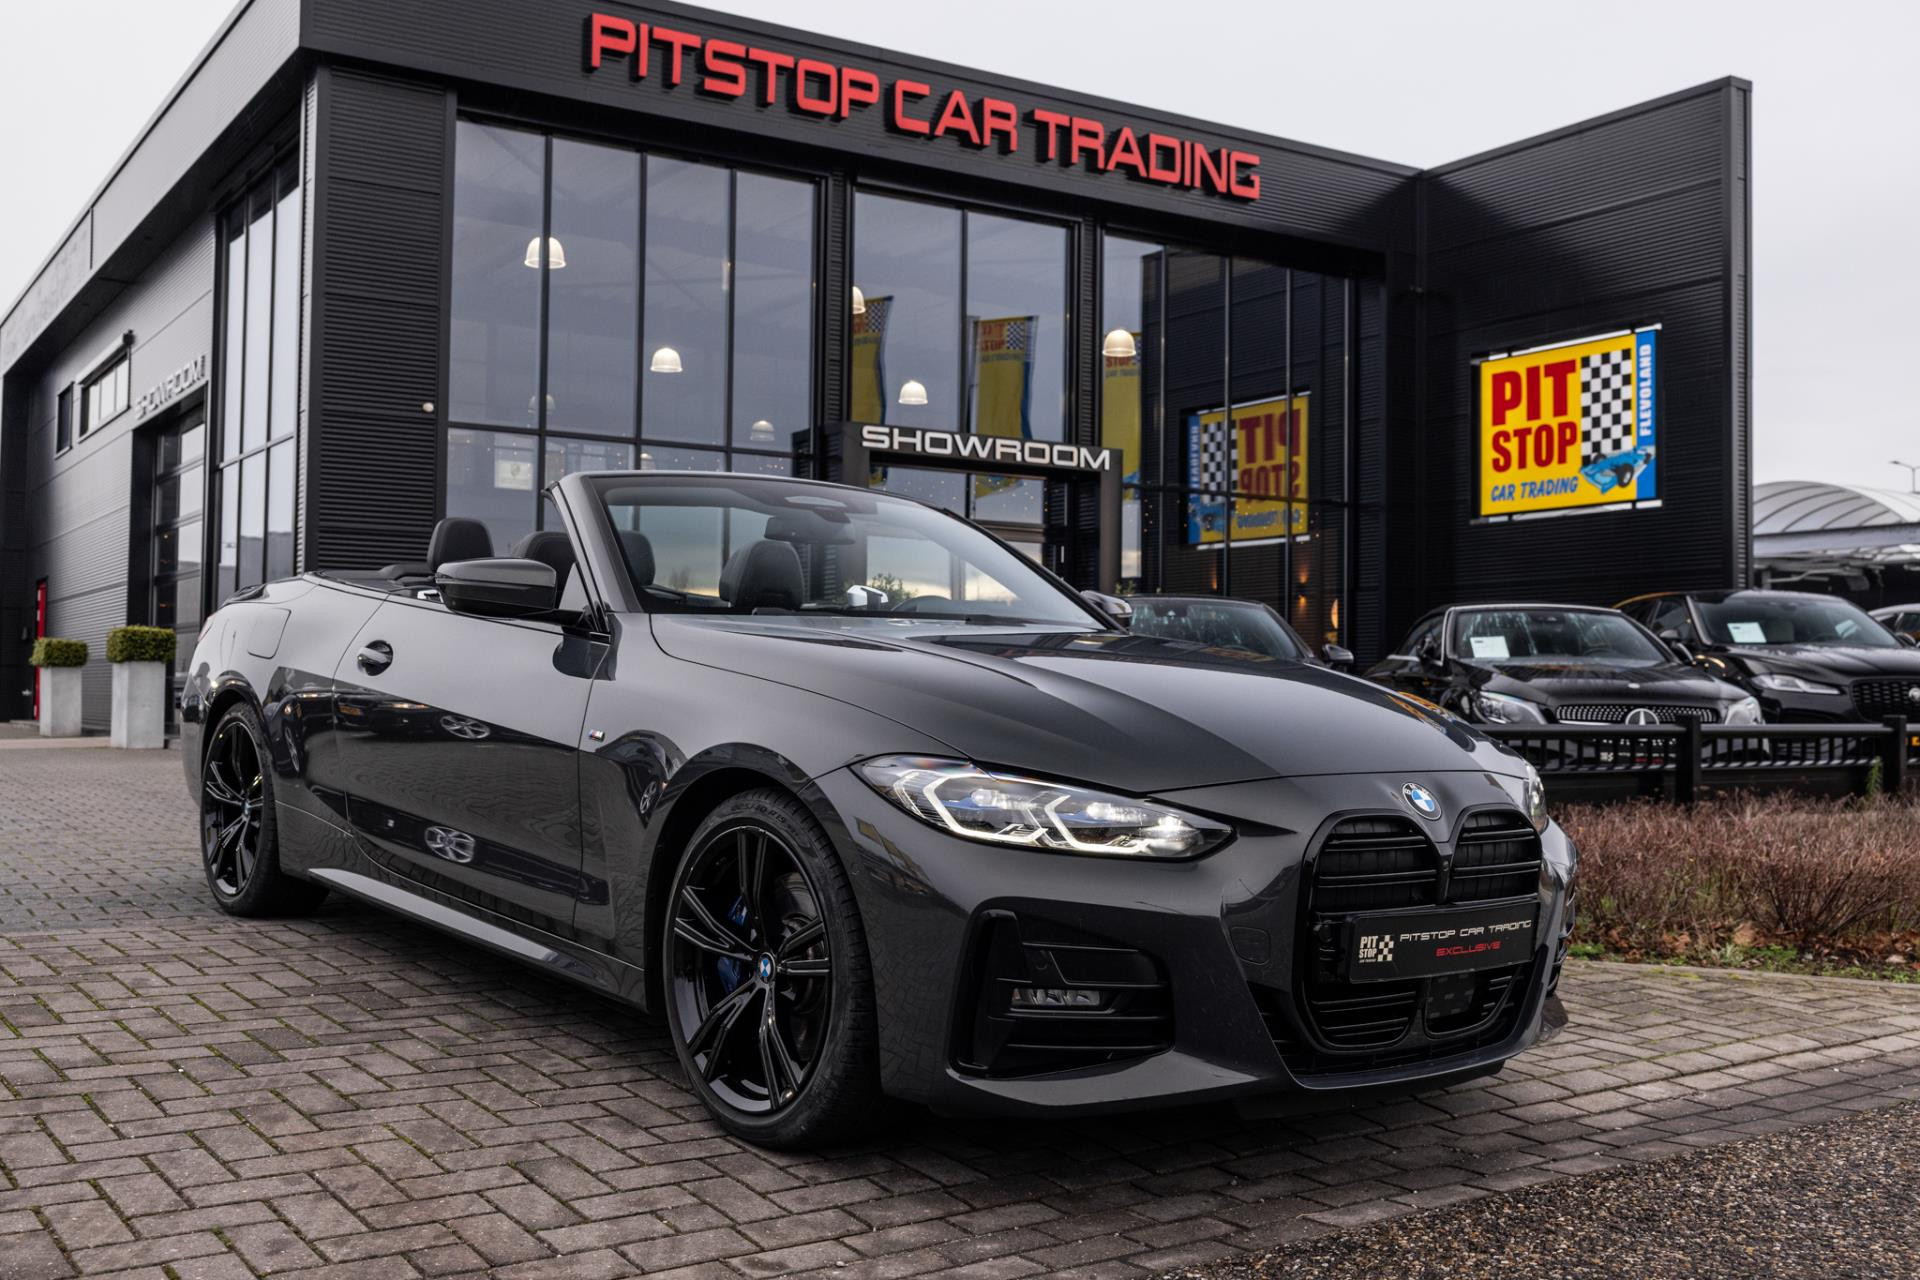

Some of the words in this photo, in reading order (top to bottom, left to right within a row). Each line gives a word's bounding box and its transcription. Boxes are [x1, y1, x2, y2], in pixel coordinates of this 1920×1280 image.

[589, 12, 880, 118] PITSTOP
[894, 80, 1018, 153] CAR
[1033, 108, 1261, 200] TRADING
[1491, 359, 1577, 427] PIT
[1639, 344, 1652, 437] FLEVOLAND
[862, 425, 1110, 471] SHOWROOM
[1491, 421, 1578, 473] STOP
[1491, 483, 1516, 502] CAR
[1520, 476, 1579, 499] TRADING
[1360, 935, 1379, 949] PIT
[1399, 929, 1456, 942] PITSTOP
[1459, 926, 1485, 937] CAR
[1488, 919, 1532, 933] TRADING
[1358, 948, 1378, 959] STOP
[1435, 941, 1502, 957] EXCLUSIVE
